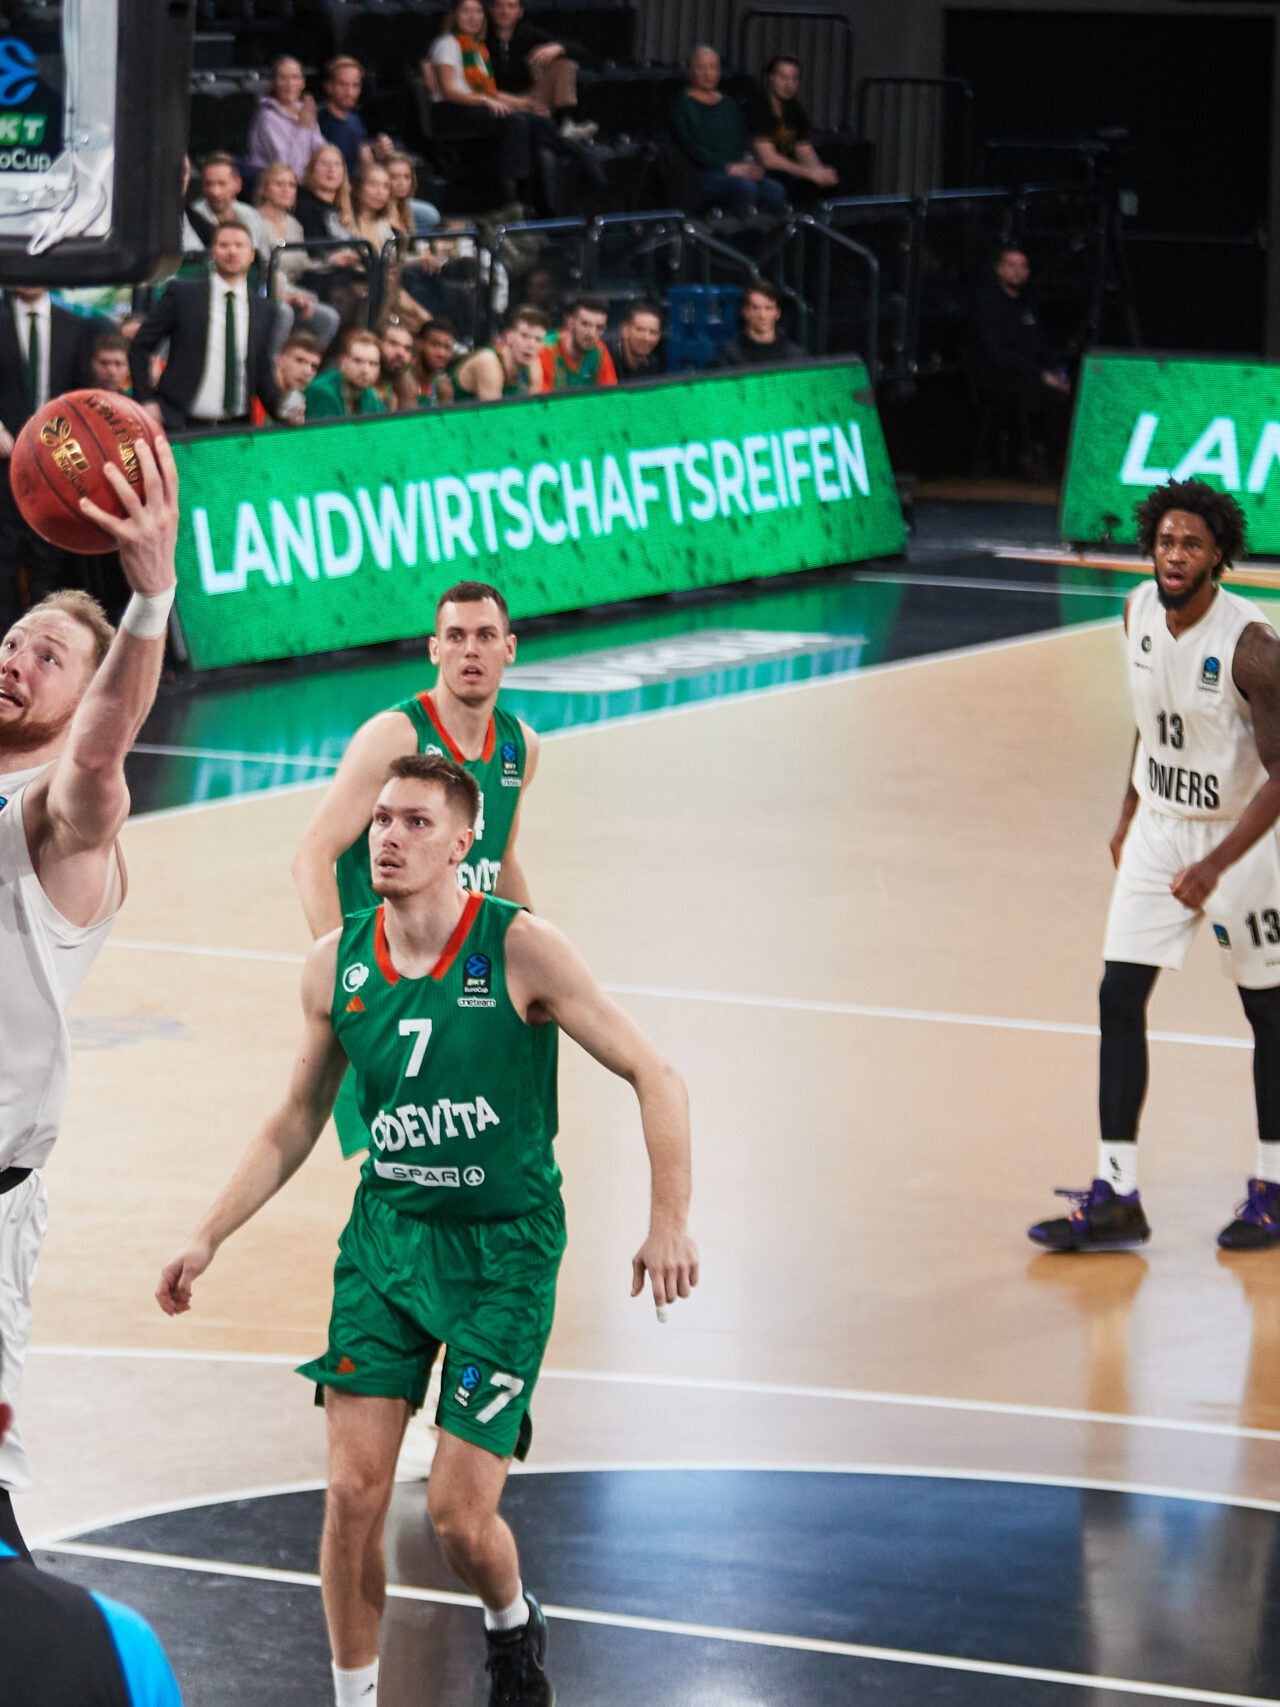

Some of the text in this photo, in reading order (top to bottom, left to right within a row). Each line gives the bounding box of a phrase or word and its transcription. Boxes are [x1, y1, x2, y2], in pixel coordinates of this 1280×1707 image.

[192, 419, 870, 596] LANDWIRTSCHAFTSREIFEN
[1157, 709, 1184, 750] 13
[1245, 907, 1280, 950] 13
[399, 1018, 432, 1078] 7
[371, 1096, 500, 1152] CDEVITA
[392, 1167, 458, 1184] SPAR
[476, 1372, 524, 1424] 7
